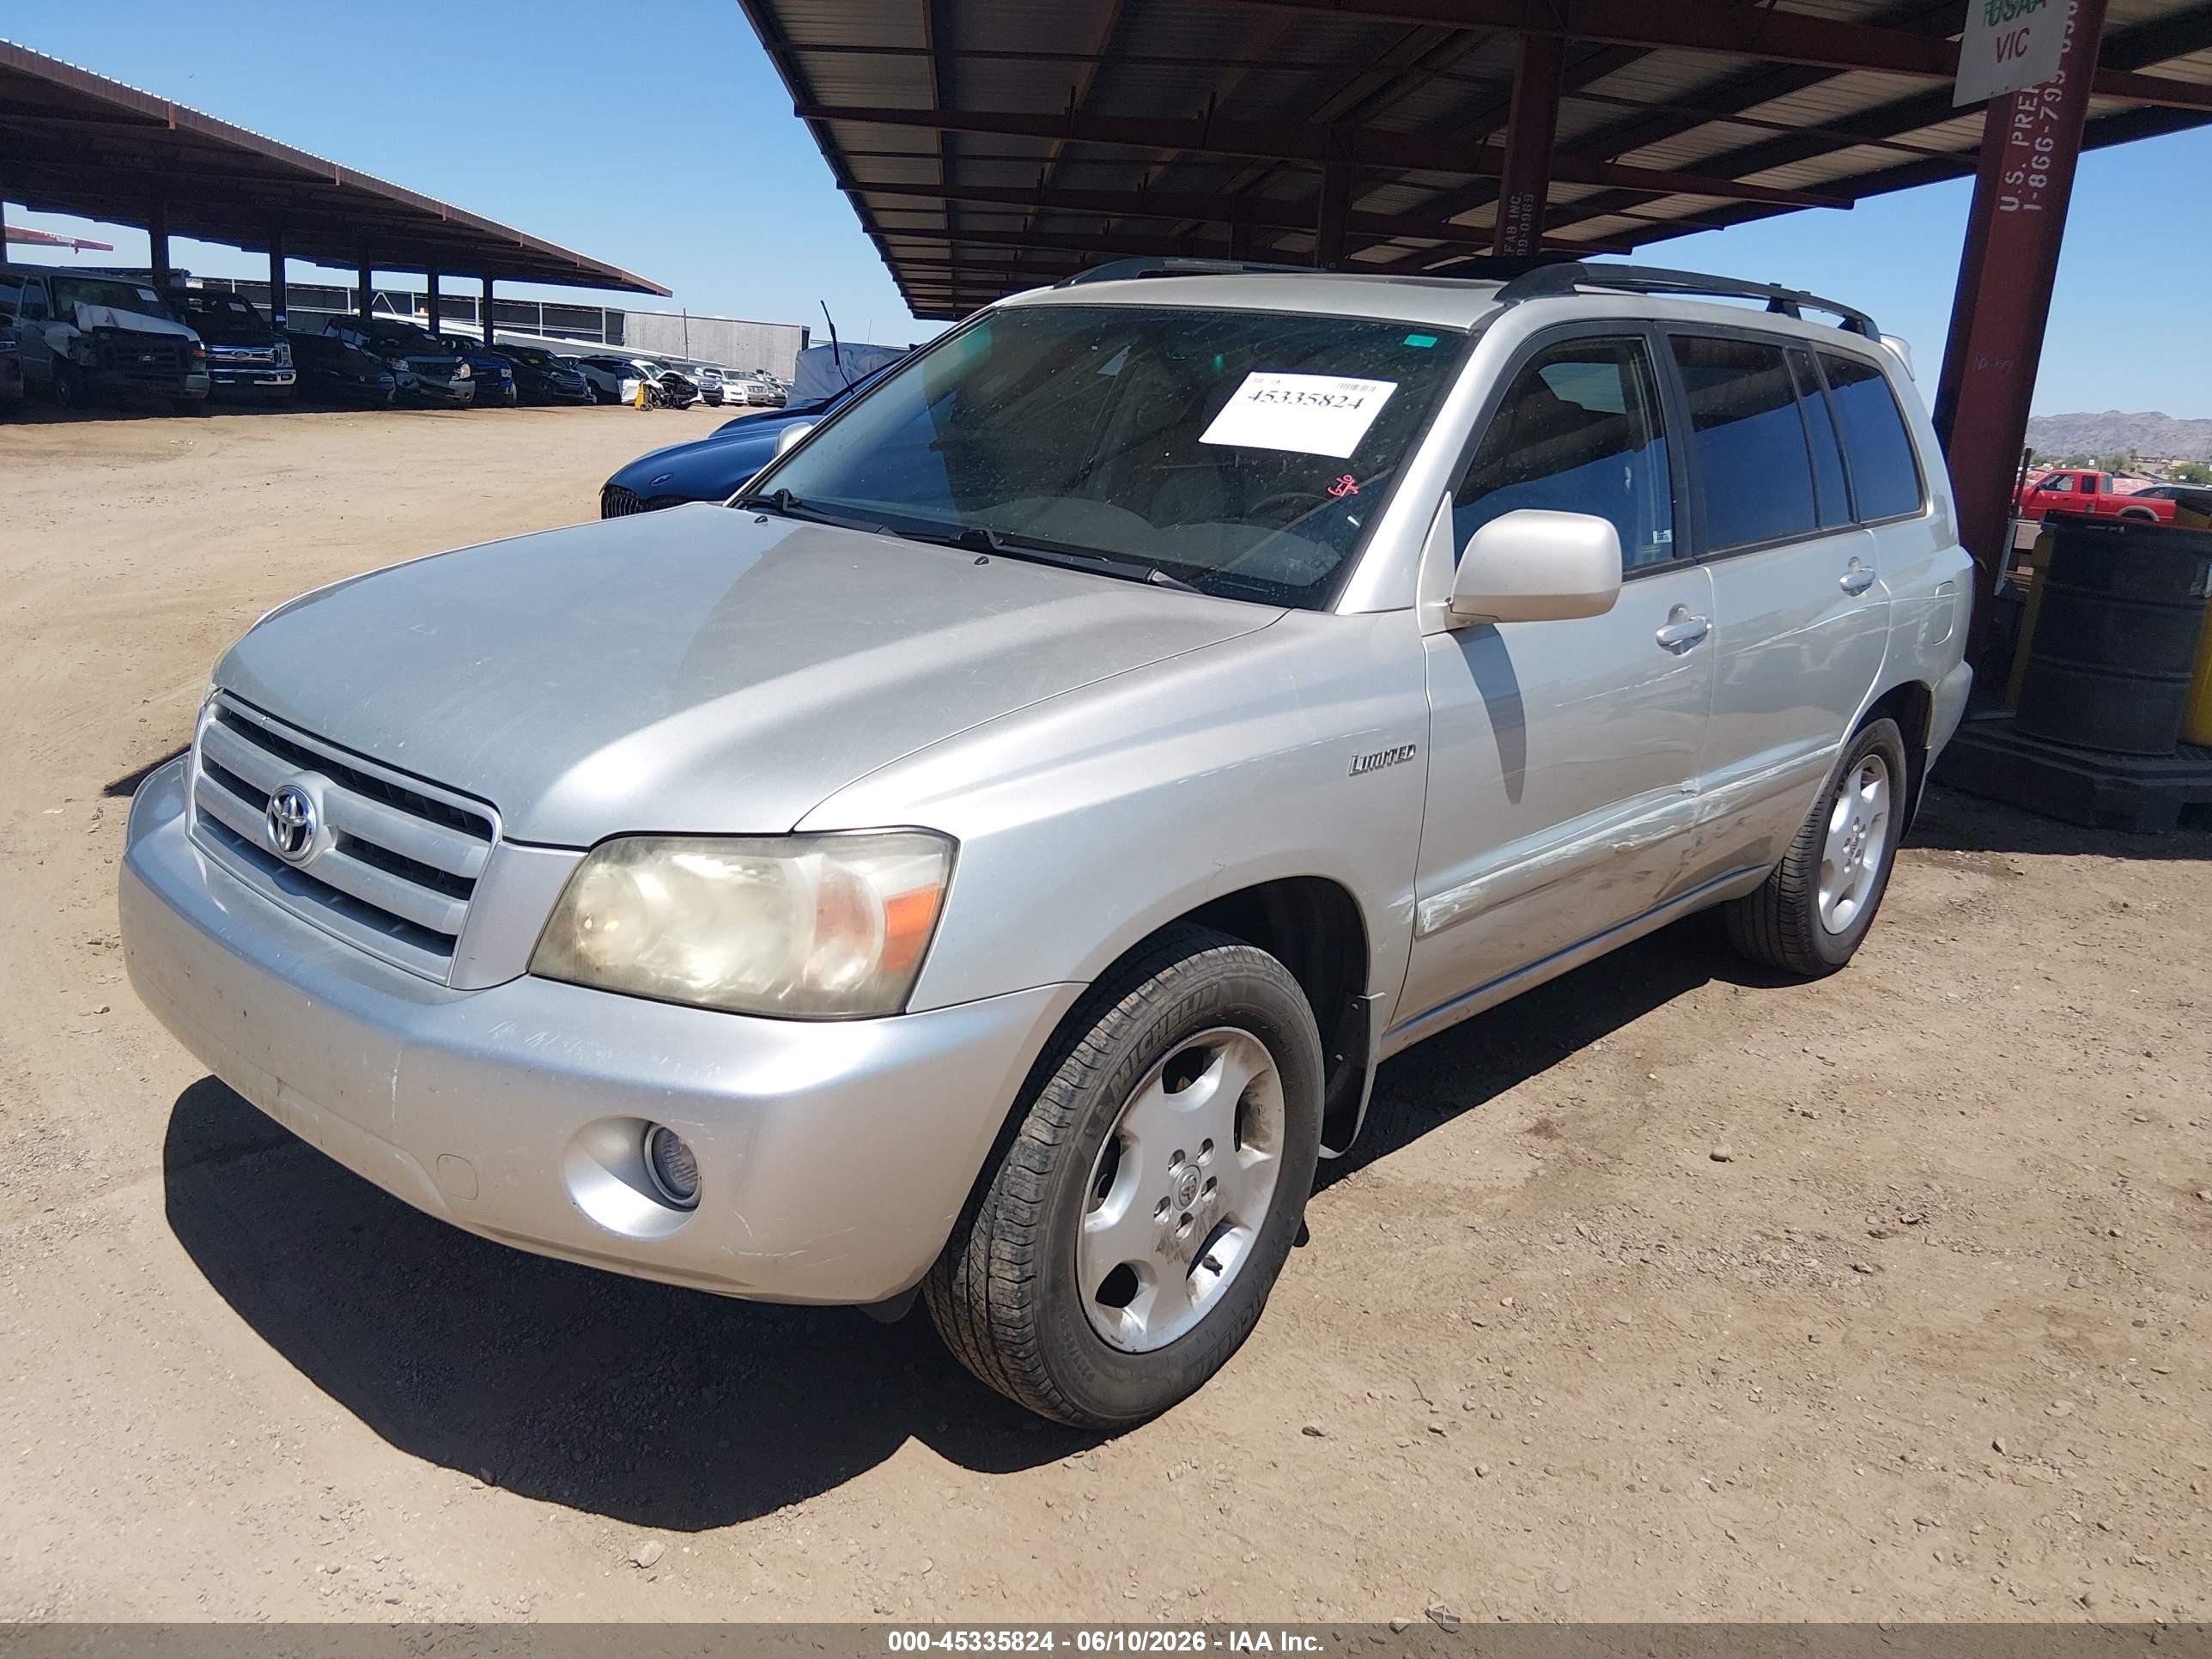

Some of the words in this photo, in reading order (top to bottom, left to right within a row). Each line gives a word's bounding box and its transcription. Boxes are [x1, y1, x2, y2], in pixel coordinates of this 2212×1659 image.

[1996, 27, 2030, 64] VIC
[1999, 162, 2027, 212] U.S.
[1248, 390, 1364, 410] 45335824
[1348, 744, 1416, 776] LIMITED
